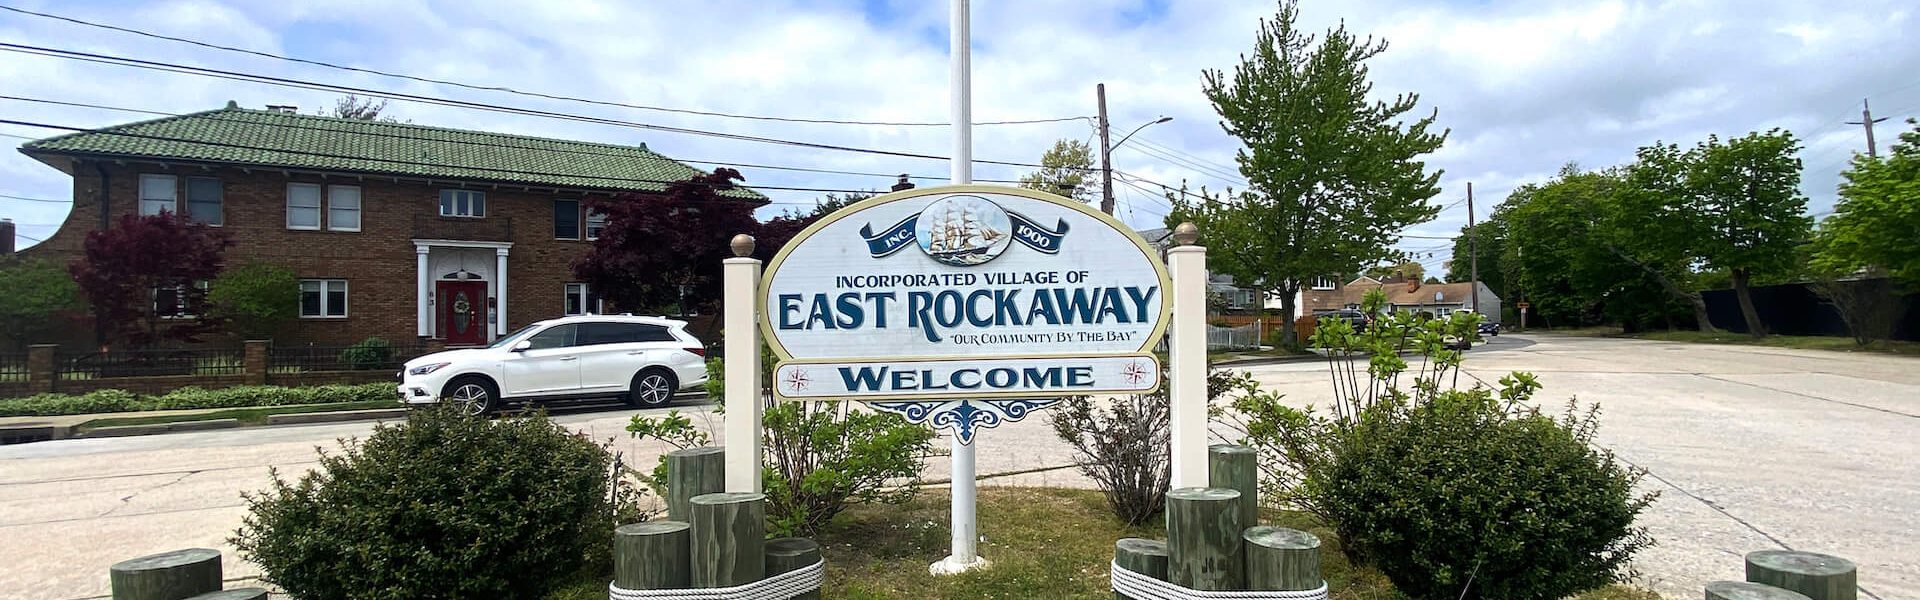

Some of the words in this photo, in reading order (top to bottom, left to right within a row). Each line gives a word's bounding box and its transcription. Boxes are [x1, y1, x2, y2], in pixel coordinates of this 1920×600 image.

[885, 230, 912, 248] INC.
[1017, 225, 1050, 248] 1900
[836, 273, 976, 288] INCORPORATED
[984, 272, 1059, 285] VILLAGE
[1067, 270, 1089, 284] OF
[779, 292, 896, 330] EAST
[908, 286, 1157, 342] ROCKAWAY
[981, 331, 1052, 344] COMMUNITY
[1056, 332, 1073, 342] BY
[1077, 331, 1103, 342] THE
[838, 366, 1095, 391] WELCOME
